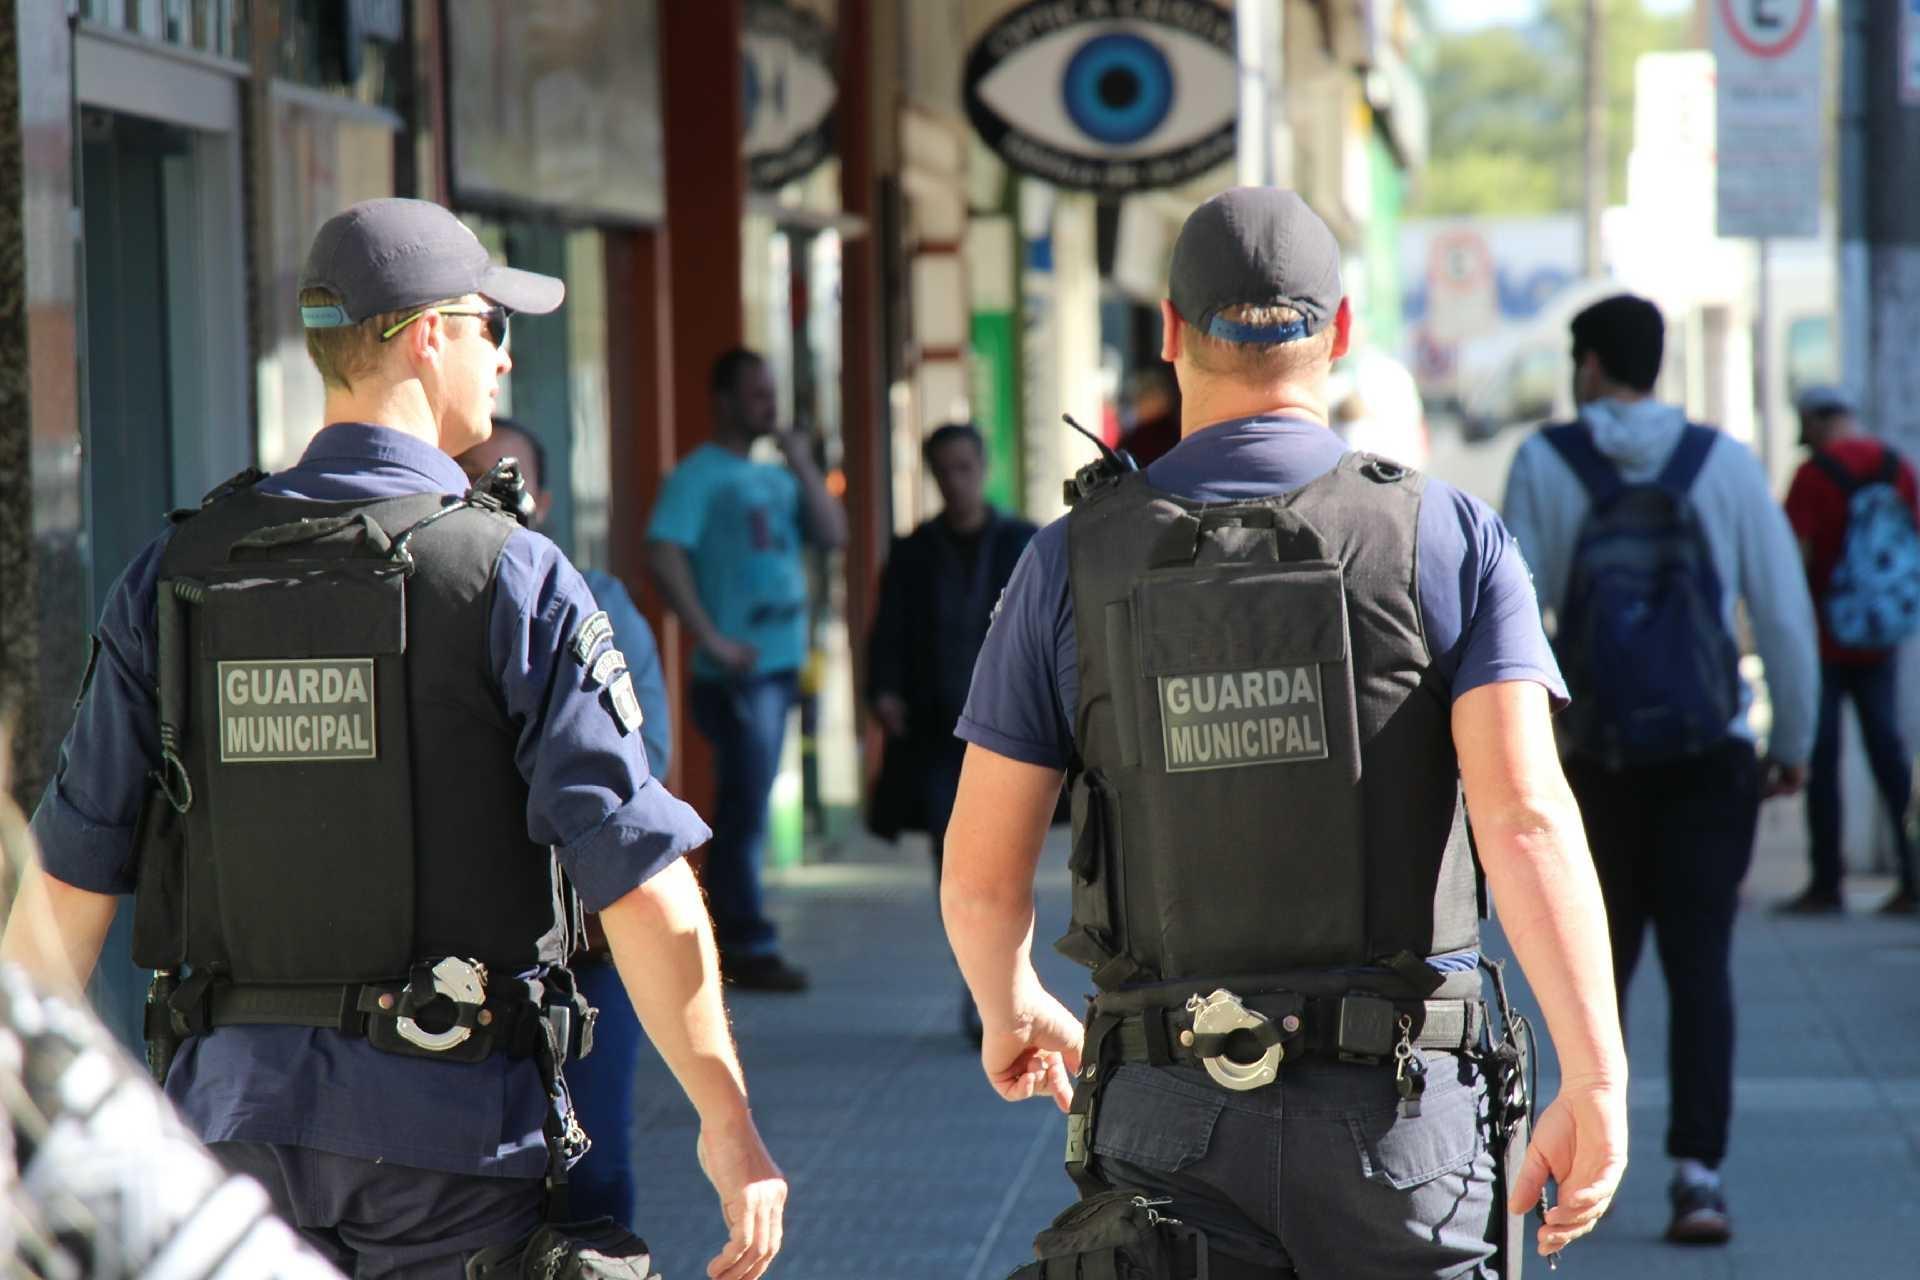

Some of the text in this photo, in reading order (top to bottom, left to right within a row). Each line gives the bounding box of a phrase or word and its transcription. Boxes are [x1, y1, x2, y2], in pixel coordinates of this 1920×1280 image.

[226, 667, 368, 705] GUARDA
[1166, 667, 1316, 715] GUARDA
[227, 713, 369, 753] MUNICIPAL
[1170, 715, 1320, 764] MUNICIPAL
